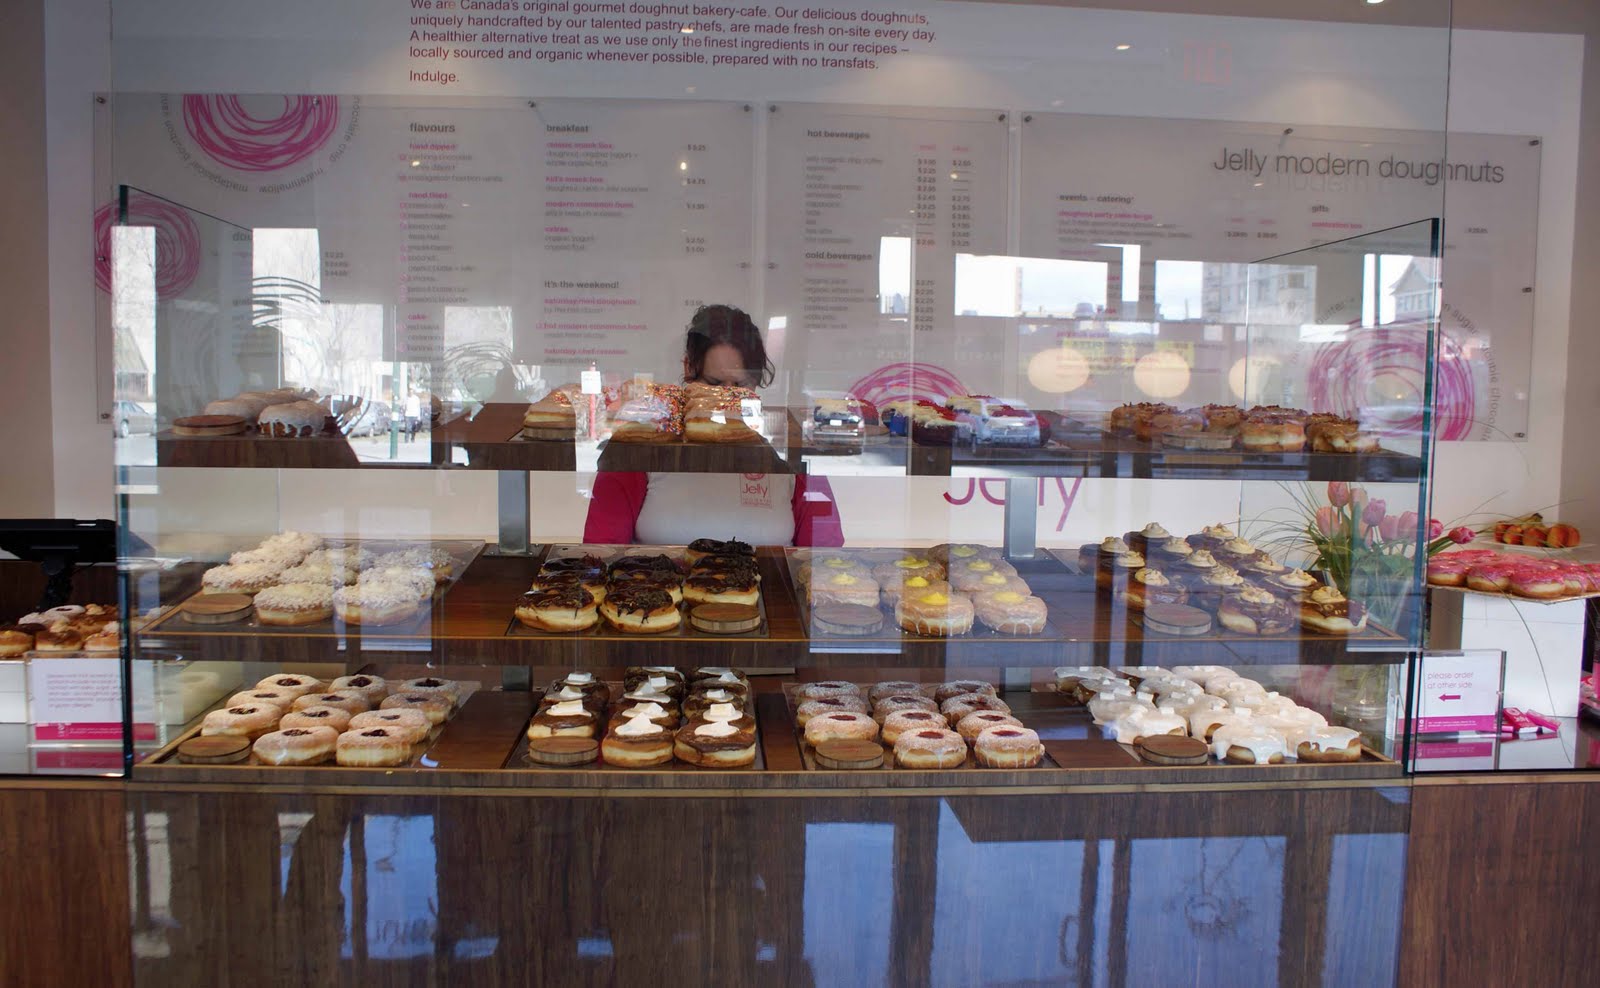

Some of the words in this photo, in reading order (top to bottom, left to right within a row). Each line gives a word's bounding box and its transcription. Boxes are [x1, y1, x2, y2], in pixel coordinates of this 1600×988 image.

[411, 0, 431, 9] We
[436, 2, 455, 10] are
[461, 0, 518, 11] Canada's
[523, 1, 569, 15] original
[573, 3, 625, 16] gourmet
[630, 3, 688, 16] doughnut
[693, 4, 771, 19] bakery-cafe.
[775, 6, 799, 19] Our
[802, 8, 857, 21] delicious
[861, 10, 929, 25] doughnuts,
[411, 14, 463, 28] uniquely
[468, 15, 543, 27] handcrafted
[548, 17, 562, 30] by
[566, 21, 586, 30] our
[591, 19, 641, 30] talented
[646, 20, 684, 33] pastry
[688, 21, 725, 32] chefs,
[730, 23, 750, 32] are
[755, 23, 789, 34] made
[794, 23, 824, 35] fresh
[829, 25, 870, 37] on-site
[875, 29, 908, 41] every
[913, 29, 936, 43] day.
[410, 31, 419, 41] A
[423, 31, 477, 42] healthier
[482, 32, 547, 43] alternative
[552, 33, 580, 43] treat
[584, 36, 598, 44] as
[603, 36, 621, 45] we
[625, 37, 648, 45] use
[652, 37, 678, 49] only
[683, 37, 701, 47] the
[704, 37, 737, 48] finest
[741, 38, 809, 51] ingredients
[814, 40, 824, 50] in
[829, 43, 849, 52] our
[853, 43, 897, 56] recipes
[410, 47, 449, 60] locally
[454, 48, 504, 58] sourced
[508, 48, 531, 59] and
[536, 50, 582, 62] organic
[587, 50, 648, 61] whenever
[652, 51, 708, 64] possible,
[713, 54, 768, 67] prepared
[773, 55, 797, 66] with
[802, 58, 817, 66] no
[822, 57, 879, 69] transfats.
[410, 70, 459, 85] Indulge.
[409, 122, 456, 133] flavours
[546, 124, 589, 133] breakfast
[807, 129, 822, 137] hot
[824, 130, 870, 140] beverages
[1214, 147, 1267, 178] Jelly
[1275, 153, 1369, 177] modern
[1378, 155, 1505, 187] doughnuts
[805, 252, 824, 260] cold
[826, 253, 872, 261] beverages
[560, 281, 574, 289] the
[576, 281, 619, 290] weekend!
[1452, 308, 1479, 335] sugar
[742, 483, 768, 498] Jelly
[1427, 672, 1452, 680] please
[1453, 671, 1473, 679] order
